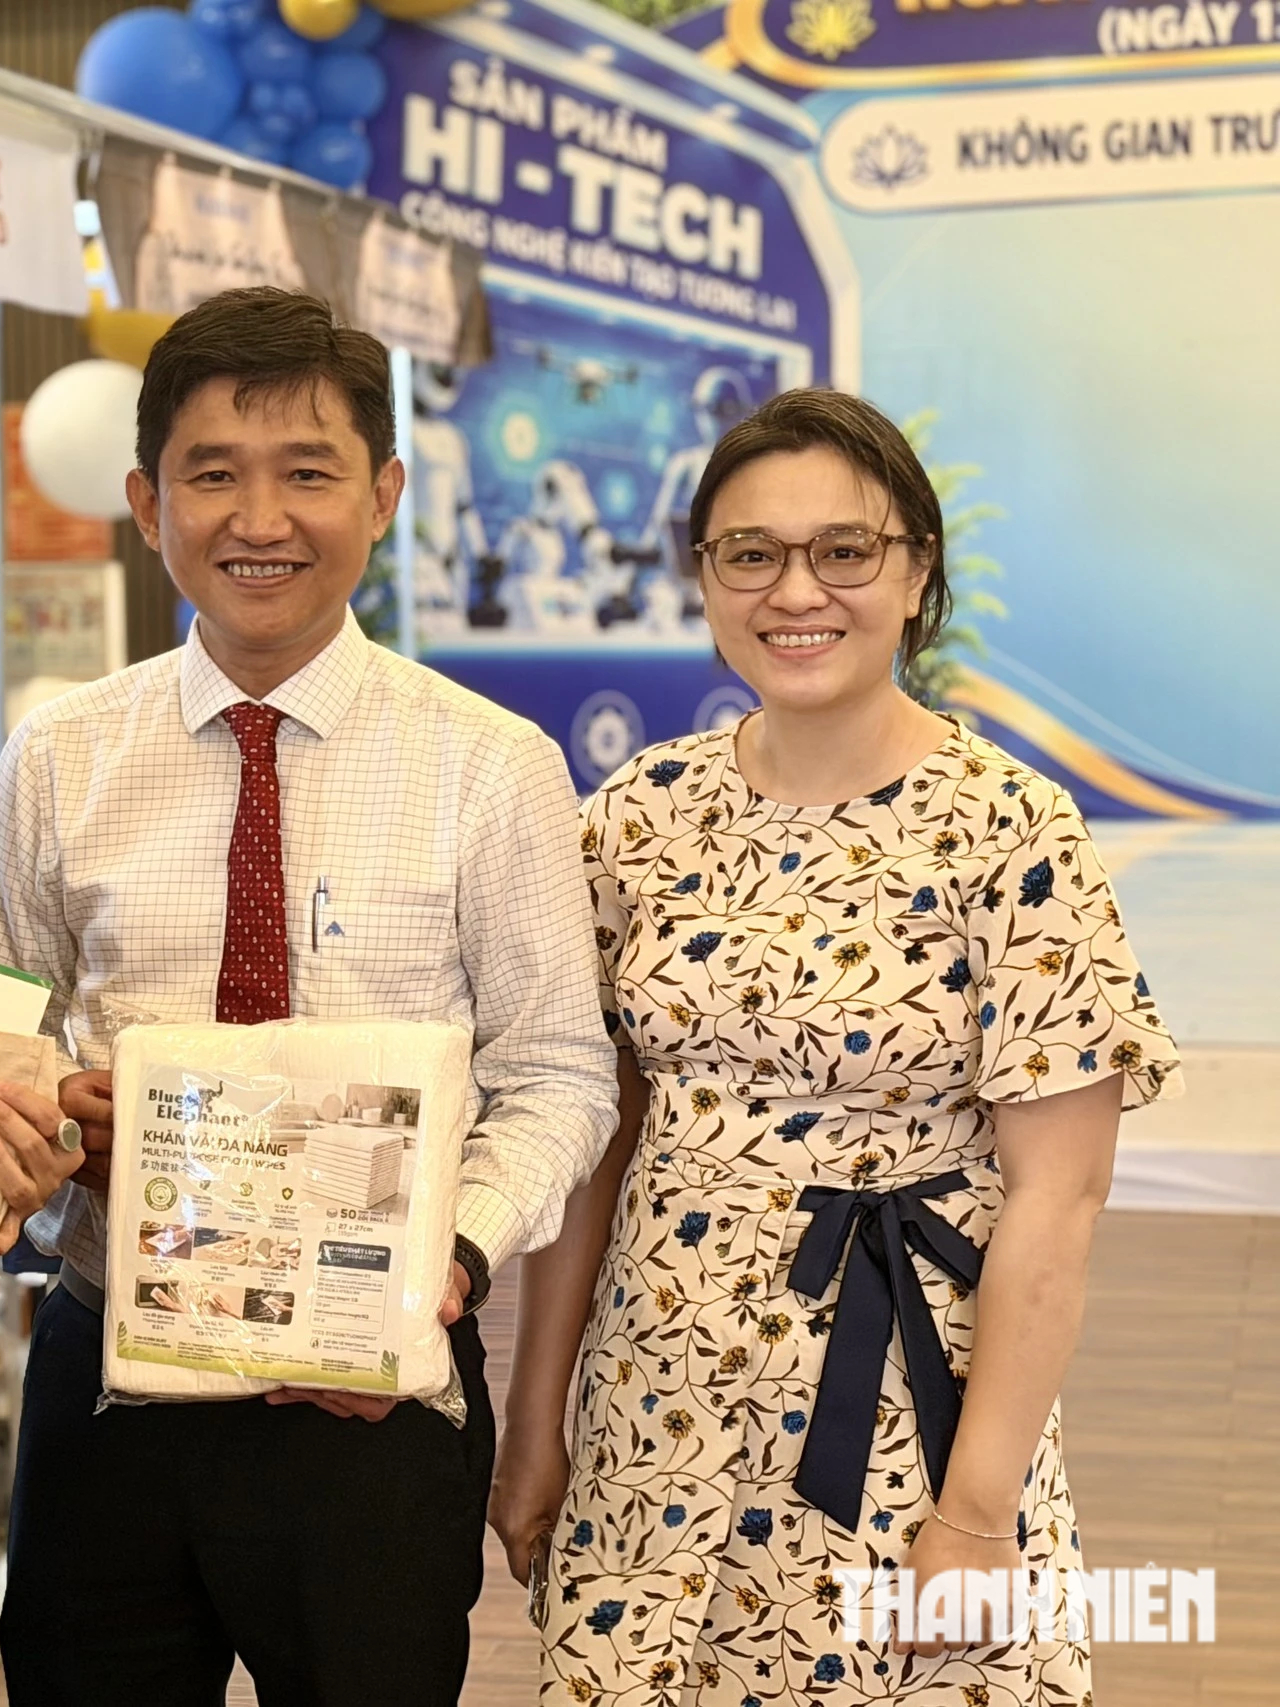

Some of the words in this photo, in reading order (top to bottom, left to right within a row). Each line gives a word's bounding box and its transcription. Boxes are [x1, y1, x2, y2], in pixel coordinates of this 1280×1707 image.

[957, 117, 1089, 168] KHÔNG
[1104, 117, 1192, 162] GIAN
[402, 93, 505, 204] HI
[557, 143, 763, 282] TECH
[148, 1088, 184, 1104] Blue
[143, 1129, 186, 1146] KHĂN
[244, 1141, 288, 1157] NĂNG
[340, 1208, 357, 1220] 50
